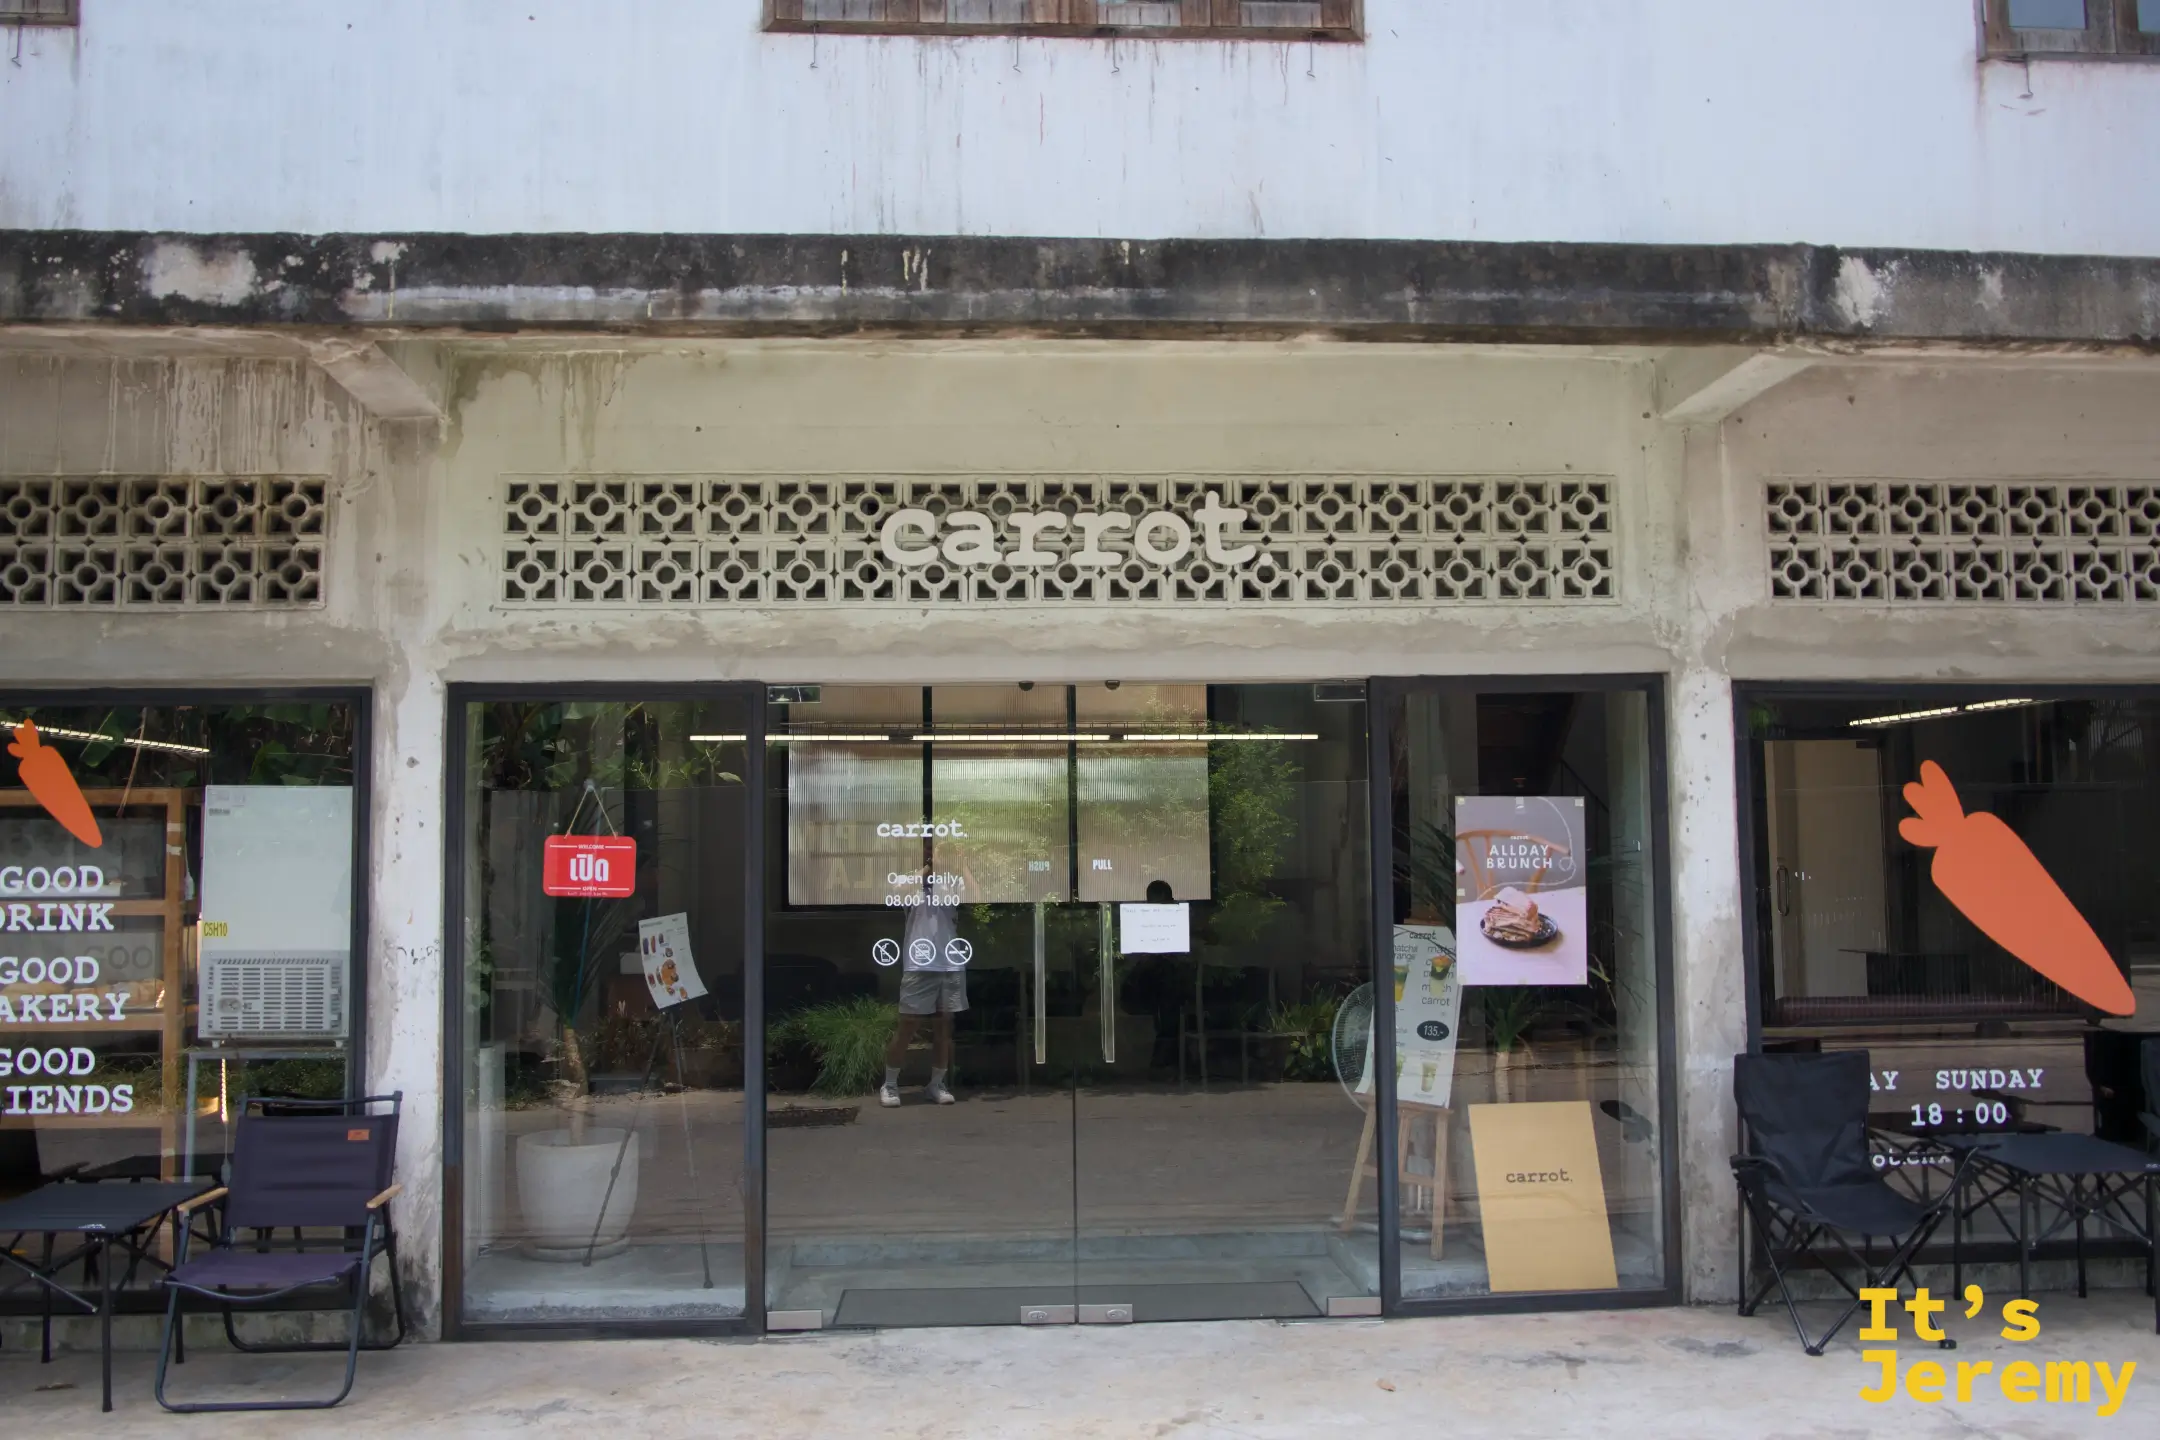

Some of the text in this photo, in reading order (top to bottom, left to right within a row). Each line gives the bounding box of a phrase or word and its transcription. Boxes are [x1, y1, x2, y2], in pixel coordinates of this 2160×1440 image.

[880, 490, 1273, 566] carrot.
[876, 820, 968, 838] carrot.
[1489, 844, 1549, 856] ALLDAY
[569, 853, 609, 882] เปิด
[1092, 859, 1113, 870] PULL
[1486, 857, 1553, 869] BRUNCH
[0, 865, 104, 893] GOOD
[887, 872, 923, 887] Open
[927, 872, 959, 888] daily
[885, 894, 960, 907] 08.00-18.00
[0, 903, 115, 931] RINK
[0, 956, 100, 984] GOOD
[1935, 1068, 2044, 1089] SUNDAY
[1506, 1167, 1573, 1183] carrot.
